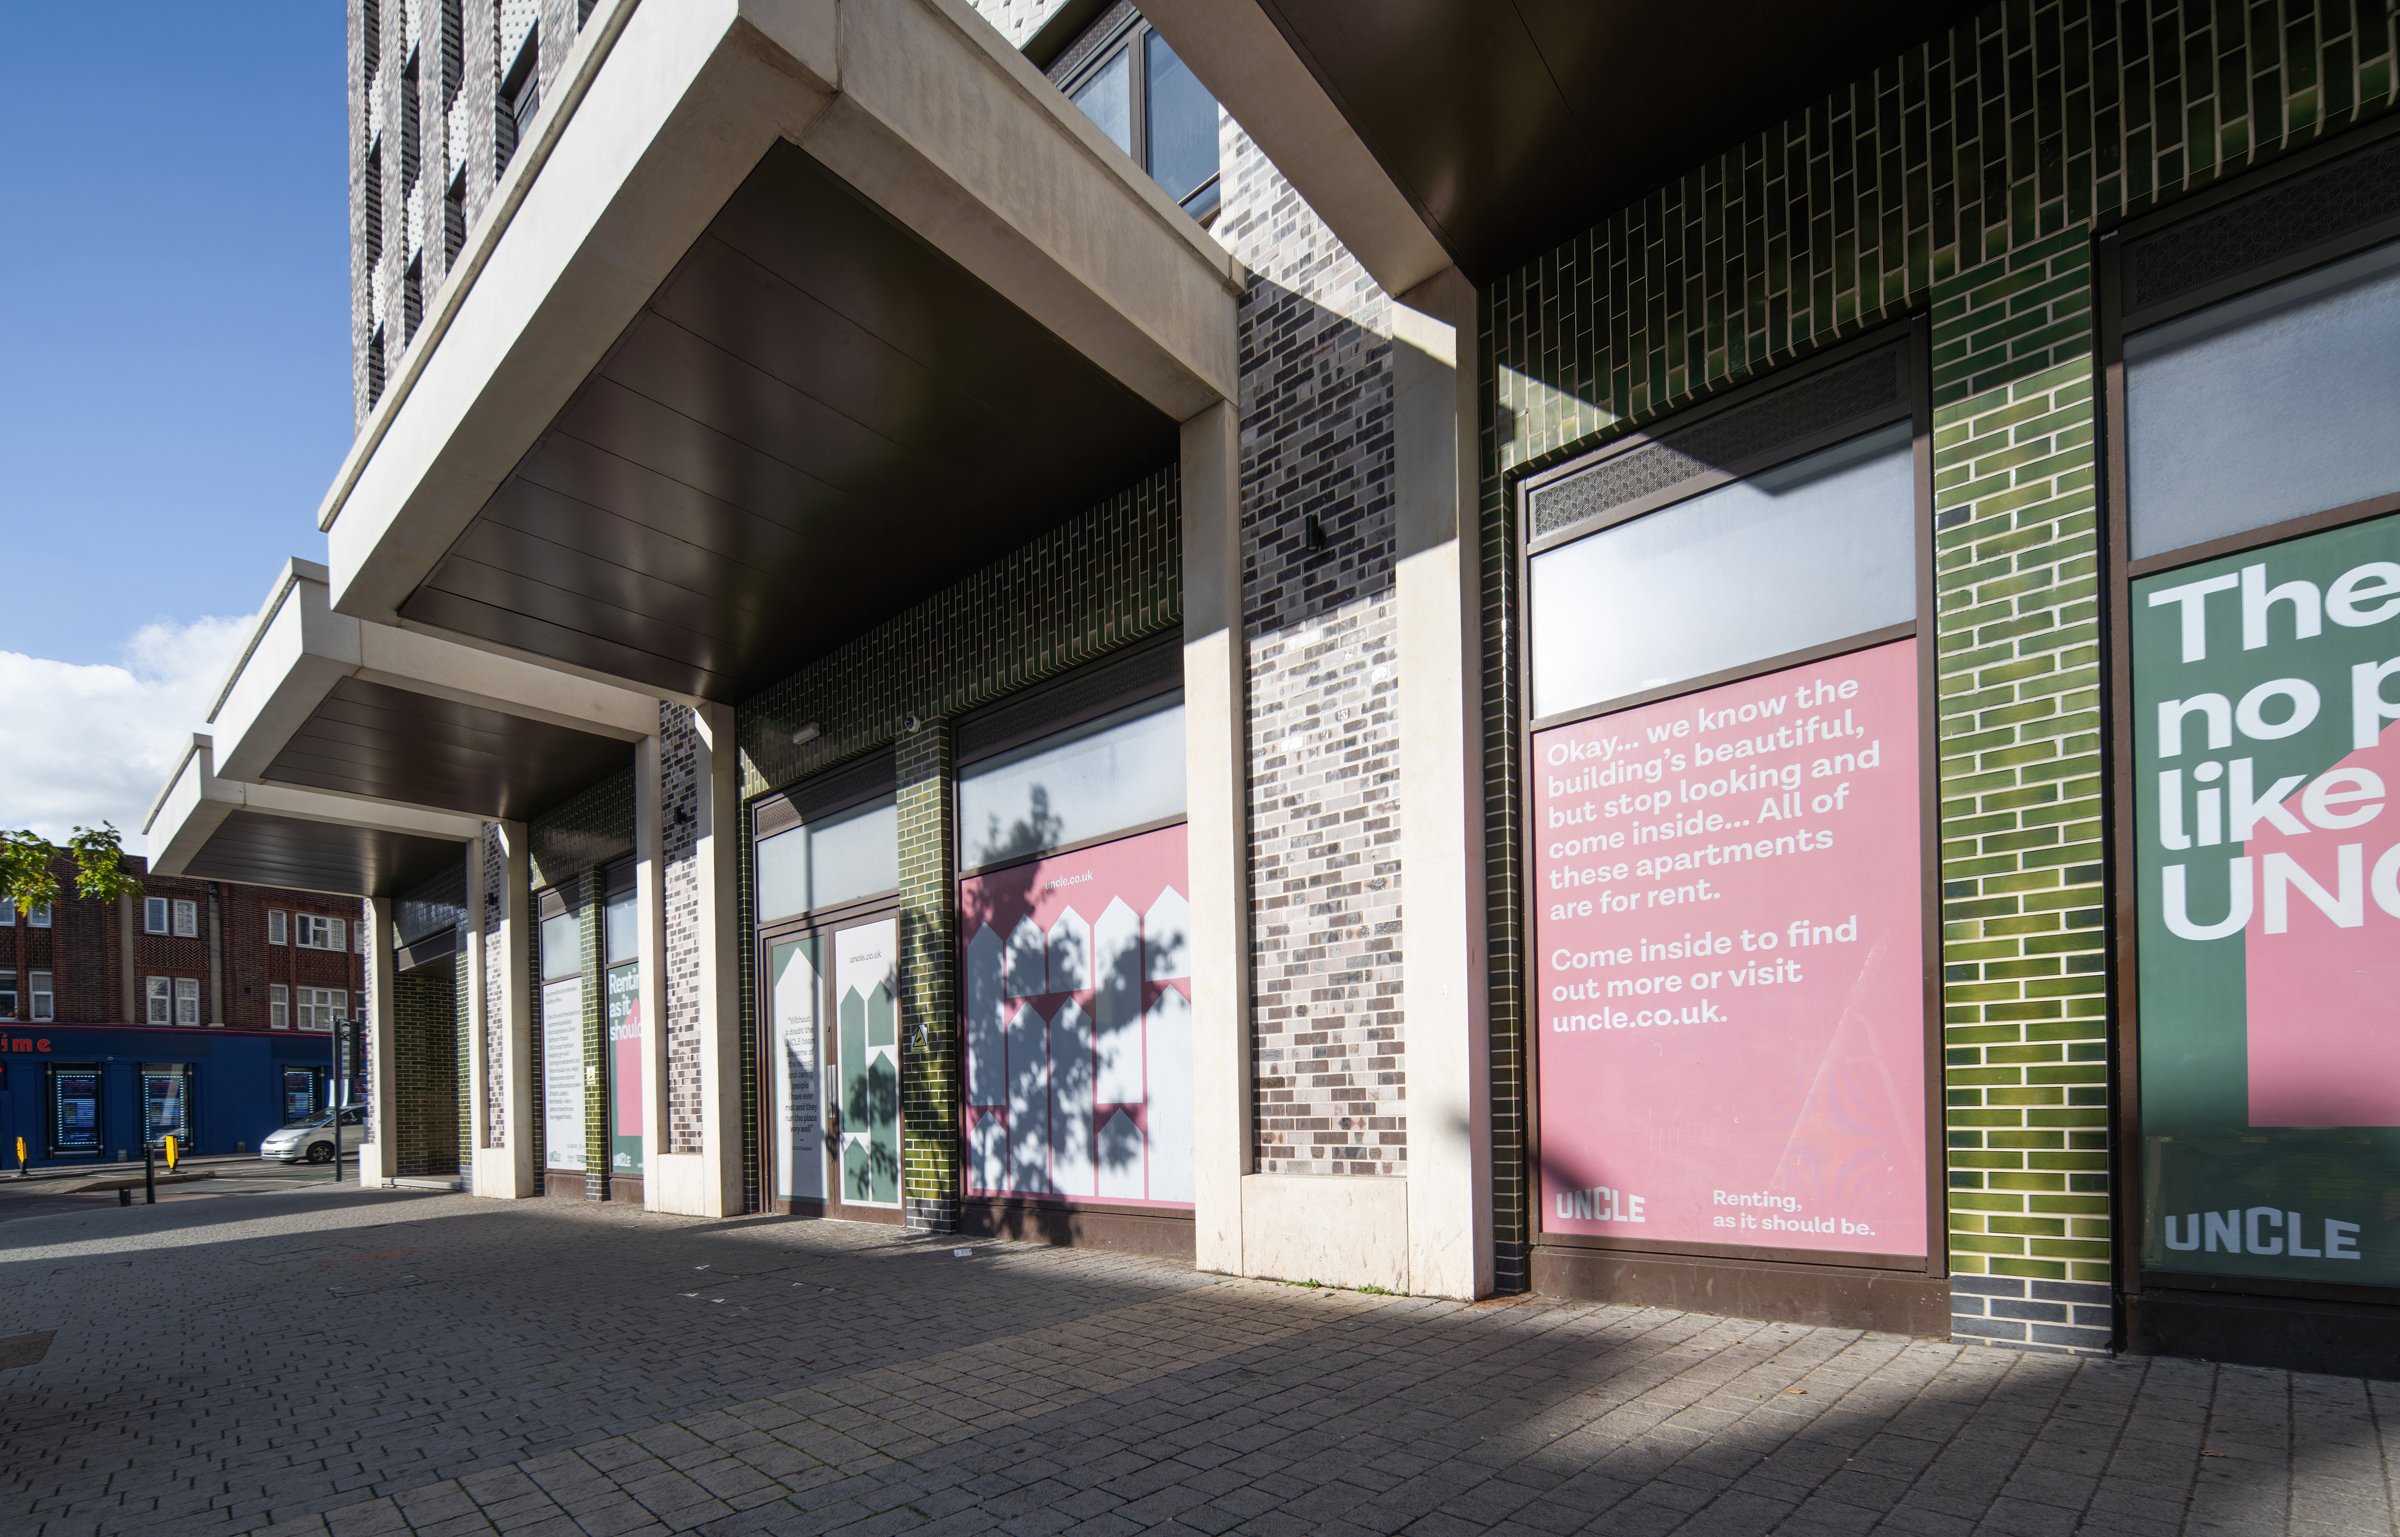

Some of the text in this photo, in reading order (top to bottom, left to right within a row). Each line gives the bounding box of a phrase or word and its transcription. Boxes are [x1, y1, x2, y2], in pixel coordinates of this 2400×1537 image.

[1547, 678, 1859, 766] Okay... we know the
[2157, 677, 2321, 758] no
[1547, 708, 1865, 798] building’s beautiful,
[1547, 740, 1881, 827] but stop looking and
[2158, 756, 2386, 851] like
[1549, 782, 1851, 859] come inside... All of
[1045, 869, 1094, 890] uncle.co.uk
[1549, 828, 1834, 890] these apartments
[1550, 879, 1721, 921] are for rent.
[849, 948, 882, 963] uncle.co.uk
[1551, 915, 1858, 971] Come inside to find
[1552, 957, 1804, 1002] out more or visit
[609, 993, 632, 1018] as it
[1552, 999, 1728, 1033] uncle.co.uk.
[1555, 1186, 1646, 1223] UNCLE
[1712, 1212, 1876, 1237] as it should be.
[1713, 1189, 1803, 1213] Renting,
[2164, 1206, 2361, 1260] UNCLE
